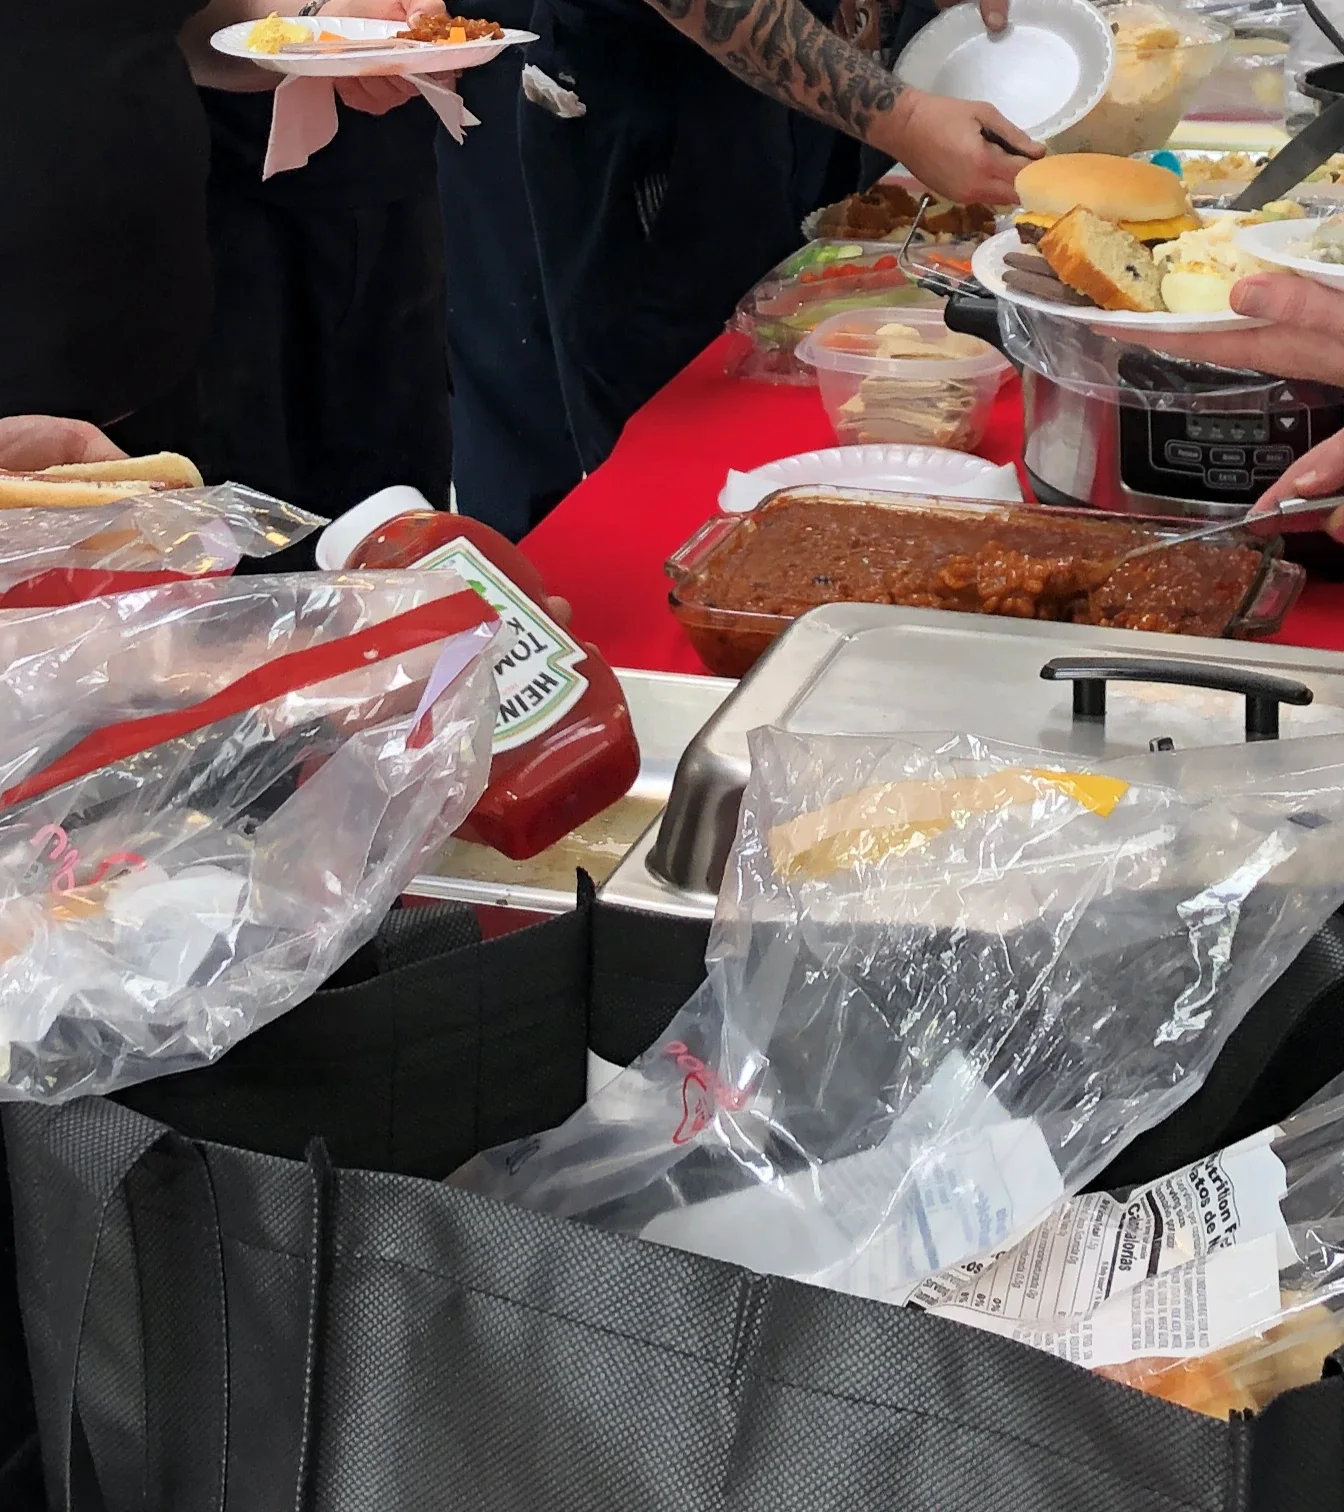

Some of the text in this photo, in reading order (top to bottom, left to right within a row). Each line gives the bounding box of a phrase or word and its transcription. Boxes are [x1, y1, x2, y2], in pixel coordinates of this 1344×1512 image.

[495, 671, 560, 728] HEIN
[1165, 1180, 1182, 1209] erving
[1203, 1211, 1216, 1234] de
